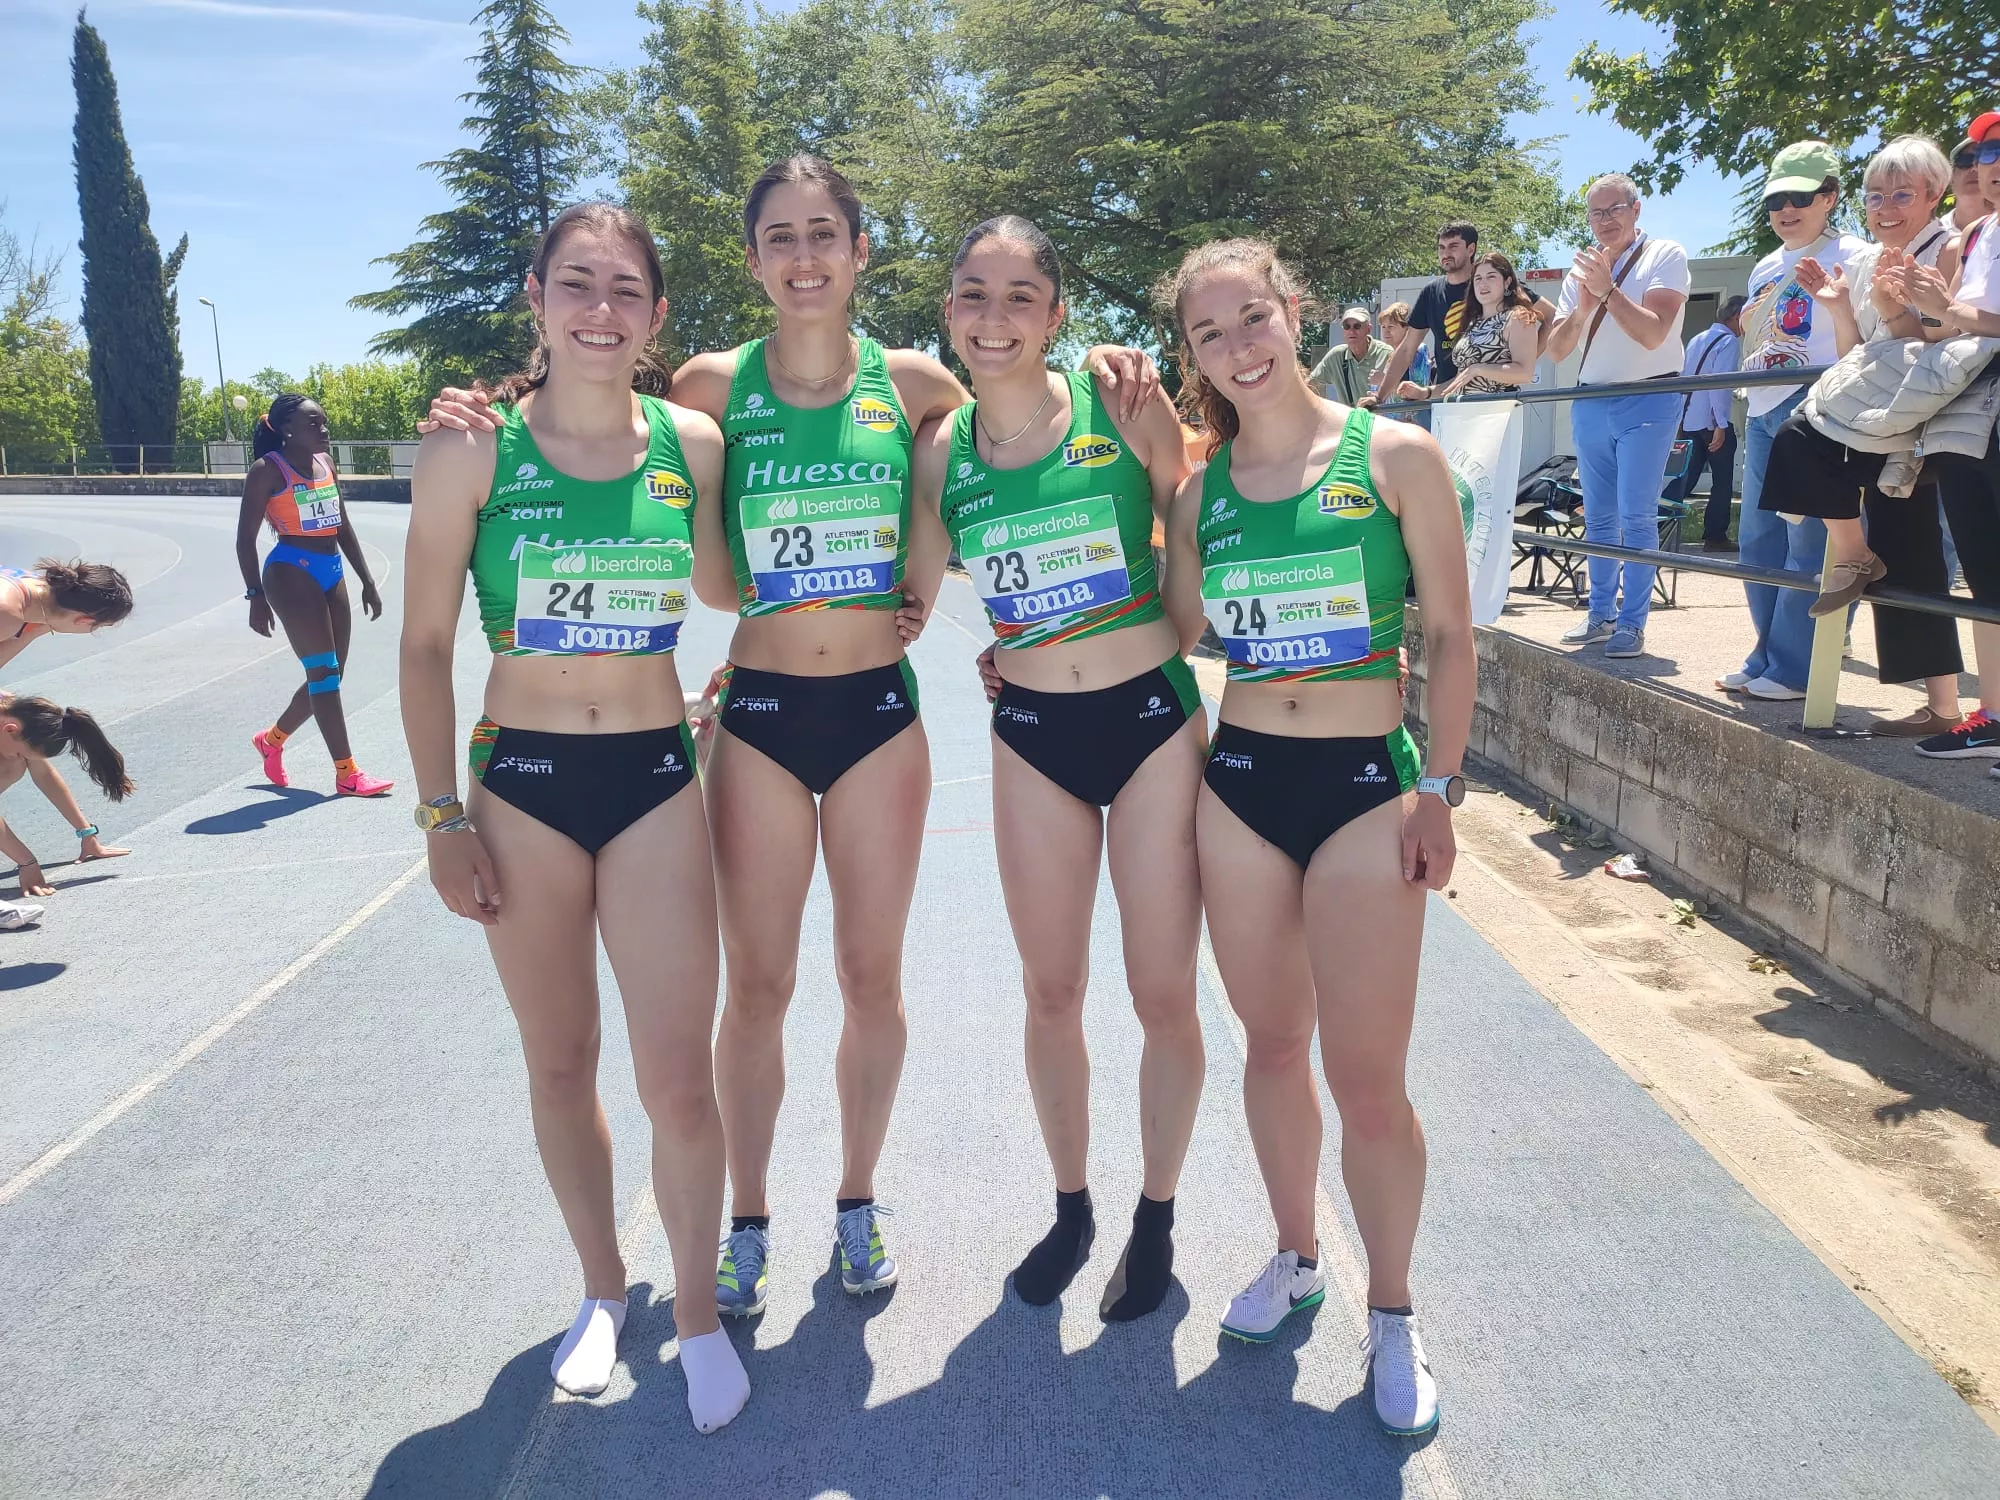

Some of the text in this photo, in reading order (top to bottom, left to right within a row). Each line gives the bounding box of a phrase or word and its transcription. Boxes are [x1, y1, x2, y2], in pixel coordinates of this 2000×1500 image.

[728, 408, 776, 421] VIATOR
[744, 427, 785, 436] ATLETISMO
[744, 435, 784, 448] ZOITI
[746, 460, 892, 489] Huesca
[498, 480, 554, 494] VIATOR
[946, 472, 986, 496] VIATOR
[802, 493, 881, 516] Iberdrola
[958, 488, 995, 506] ATLETISMO
[310, 502, 325, 517] 14
[510, 507, 563, 520] ZOITI
[958, 495, 994, 518] ZOITI
[317, 515, 341, 528] Jom
[1012, 512, 1090, 540] Iberdrola
[1200, 508, 1238, 532] VIATOR
[824, 530, 869, 540] ATLETISMO
[1207, 526, 1244, 545] ATLETISMO
[770, 526, 814, 569] 23
[825, 538, 870, 554] ZOITI
[1036, 546, 1081, 561] ATLETISMO
[591, 555, 673, 573] Iberdrola
[1039, 553, 1083, 575] ZOITI
[986, 551, 1030, 594] 23
[1253, 563, 1334, 587] Iberdrola
[546, 582, 594, 619] 24
[608, 590, 656, 598] ATLETISMO
[607, 597, 655, 613] ZOITI
[1276, 600, 1321, 610] ATLETISMO
[1224, 598, 1267, 636] 24
[1278, 608, 1322, 623] ZOITI
[747, 702, 779, 712] ZOITI
[876, 703, 905, 712] VIATOR
[1139, 706, 1171, 720] VIATOR
[1012, 713, 1039, 725] ZOITI
[517, 763, 553, 774] ZOITI
[653, 764, 684, 774] VIATOR
[1225, 758, 1252, 770] ZOITI
